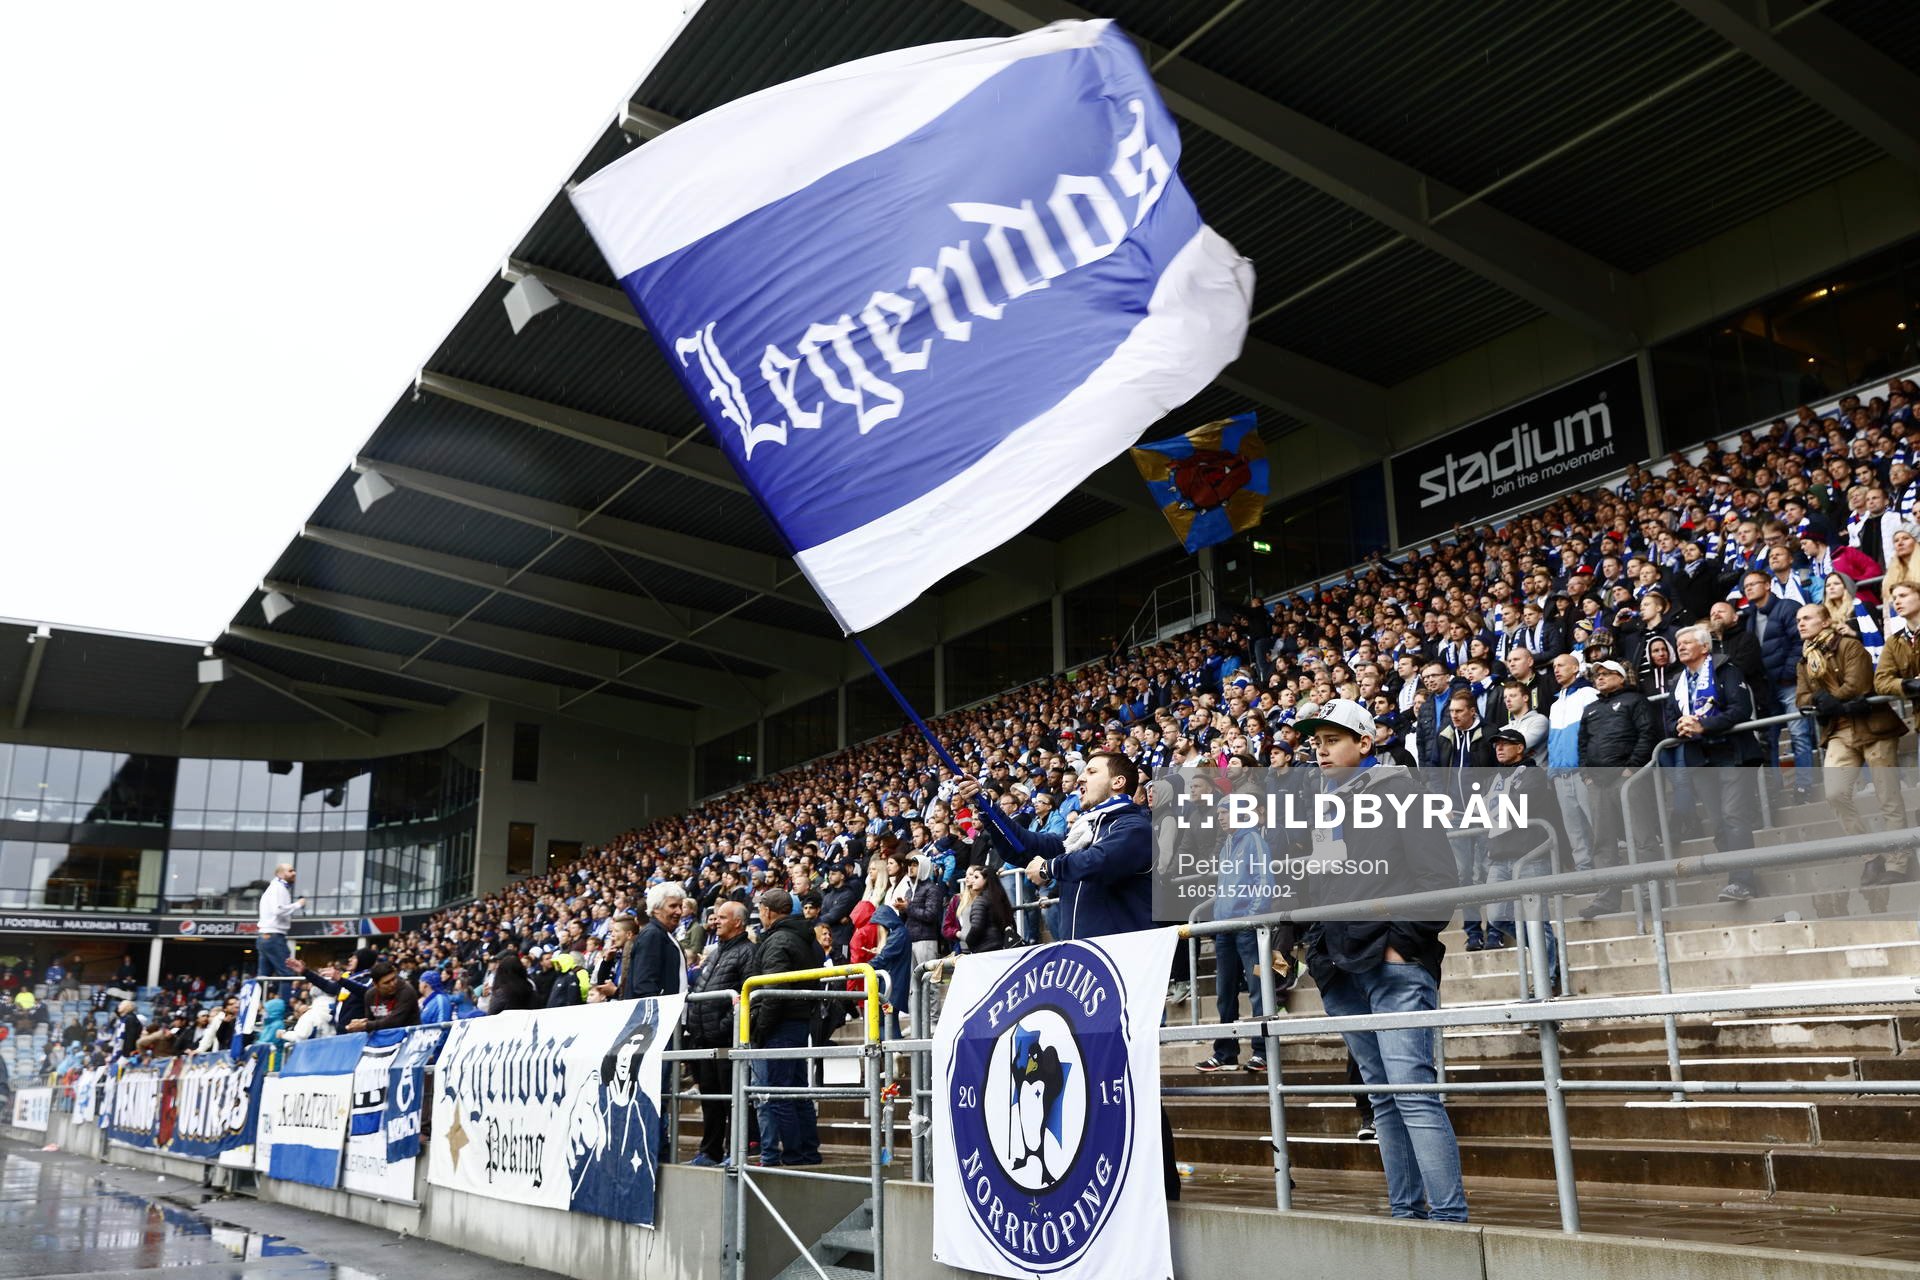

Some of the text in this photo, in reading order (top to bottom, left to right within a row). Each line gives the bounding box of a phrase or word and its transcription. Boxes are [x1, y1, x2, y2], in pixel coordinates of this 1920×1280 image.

[675, 99, 1171, 461] Legendos
[1419, 402, 1613, 509] stadium
[1491, 442, 1615, 499] Join the movement
[63, 920, 118, 930] MAXIMUM
[198, 922, 236, 935] pepsi
[986, 958, 1107, 1029] PENGUINS
[958, 1076, 1125, 1109] 20 15
[485, 1114, 546, 1188] Peking
[962, 1148, 1113, 1256] NORRKÖPING
